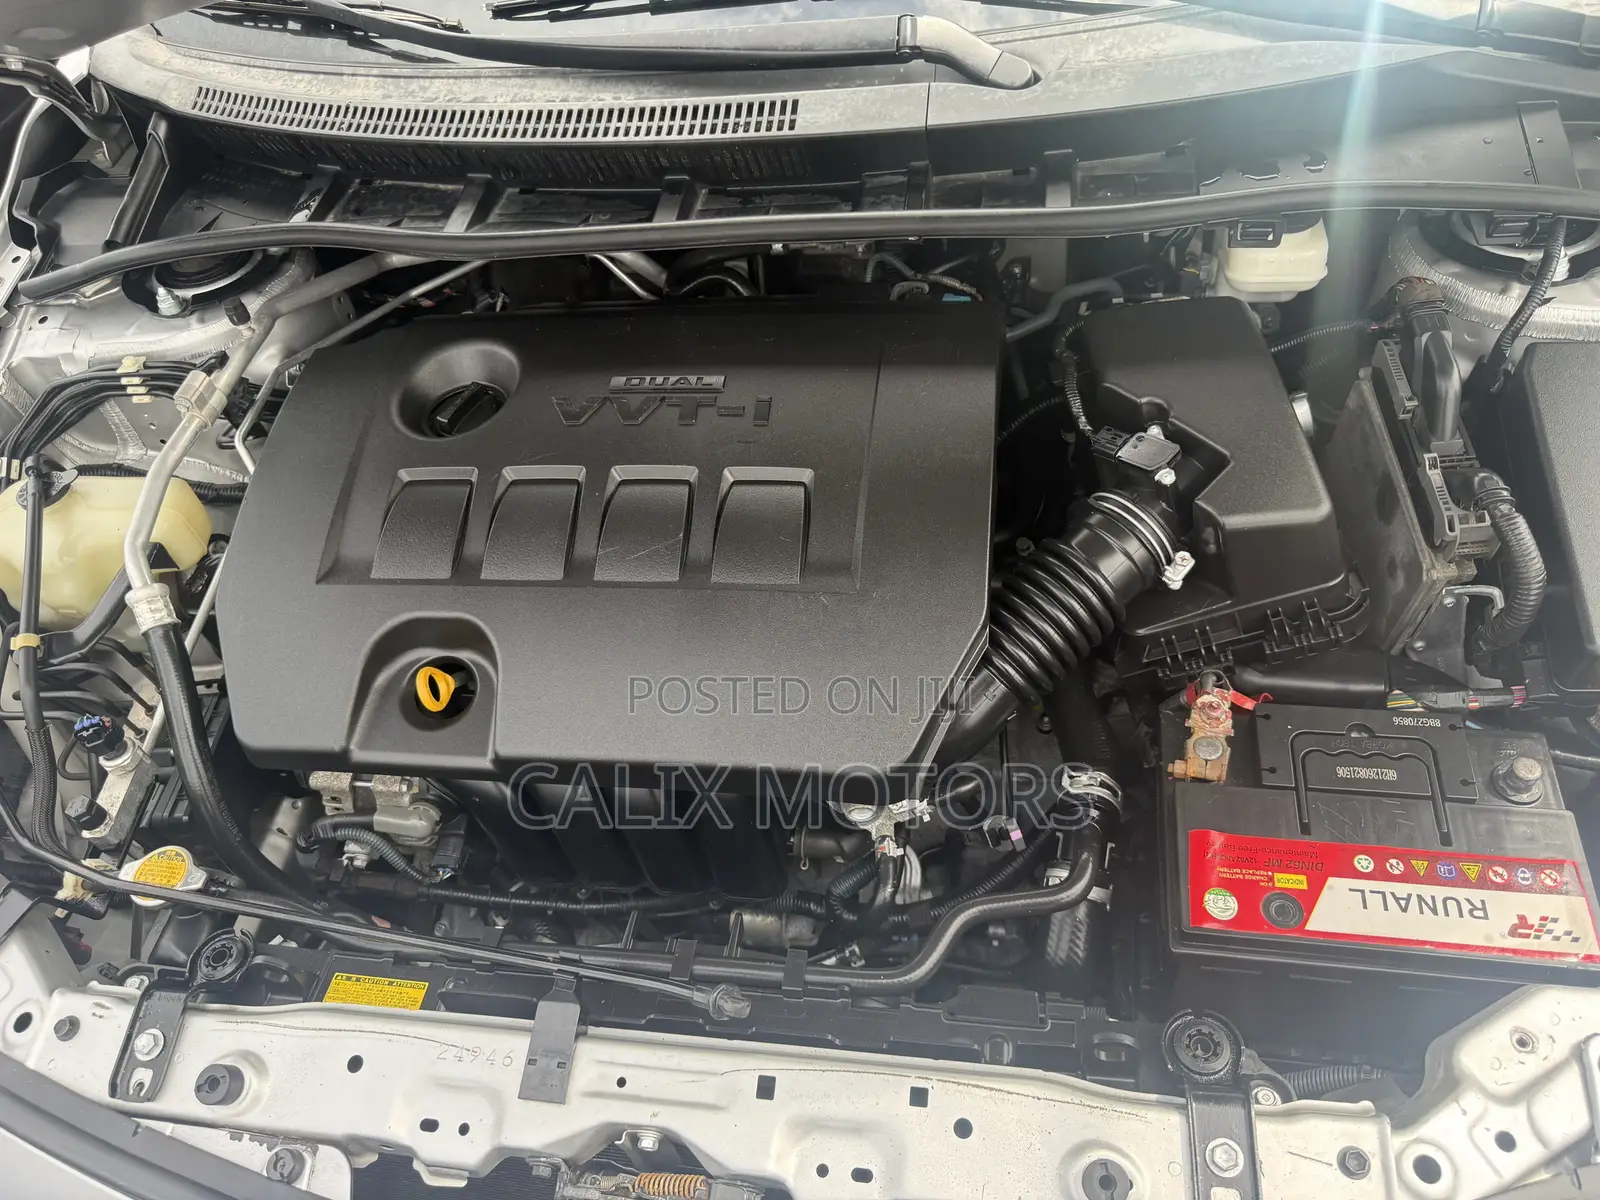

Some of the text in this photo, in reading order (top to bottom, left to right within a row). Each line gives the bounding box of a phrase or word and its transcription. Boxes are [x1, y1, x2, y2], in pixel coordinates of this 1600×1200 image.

[624, 376, 714, 387] DUAL
[1263, 857, 1283, 869] MF
[1285, 859, 1324, 872] DIN62
[1218, 872, 1244, 880] BATTERY
[1242, 868, 1268, 876] REPLACE
[1276, 876, 1305, 887] INDICATOR
[1348, 887, 1490, 921] RUNALL
